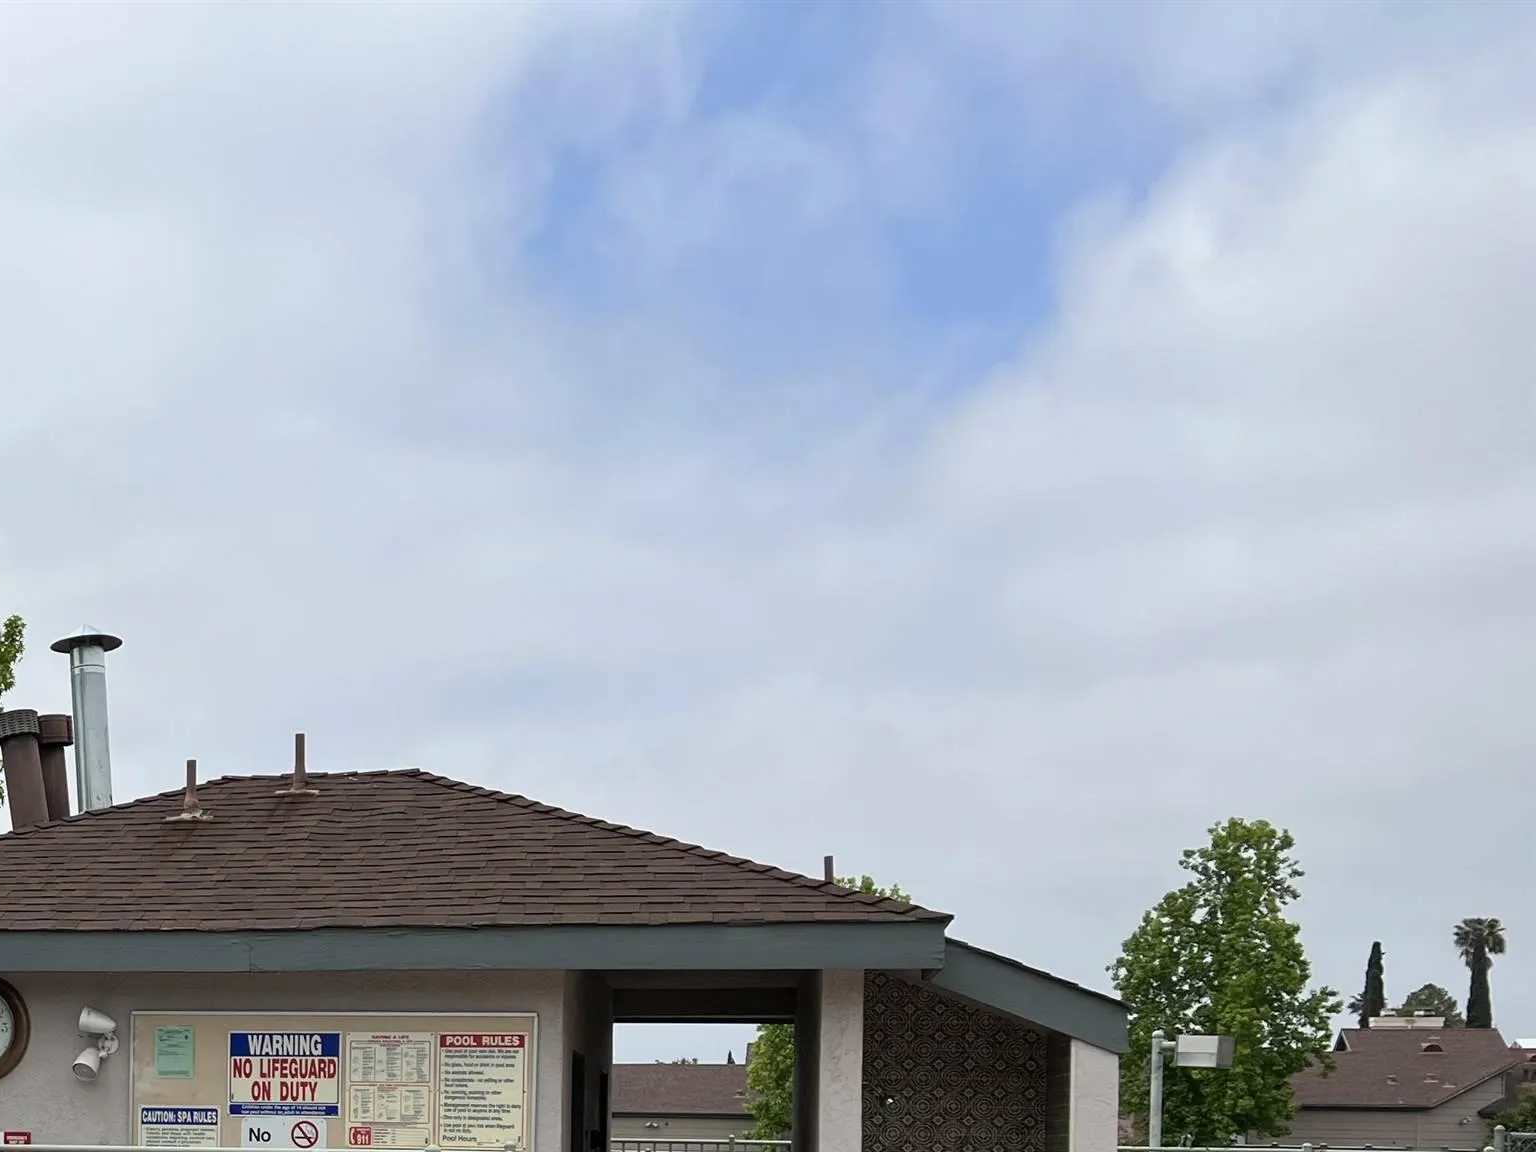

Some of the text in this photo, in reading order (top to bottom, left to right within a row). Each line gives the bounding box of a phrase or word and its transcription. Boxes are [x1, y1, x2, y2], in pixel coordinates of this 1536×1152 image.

[247, 1034, 322, 1056] WARNING
[445, 1036, 520, 1046] POOL RULES
[233, 1058, 253, 1078] NO
[260, 1058, 337, 1079] LIFEGUARD
[251, 1081, 318, 1101] ON DUTY
[142, 1110, 217, 1123] CAUTION: SPA RULES
[249, 1127, 271, 1142] No
[442, 1134, 457, 1142] Pool
